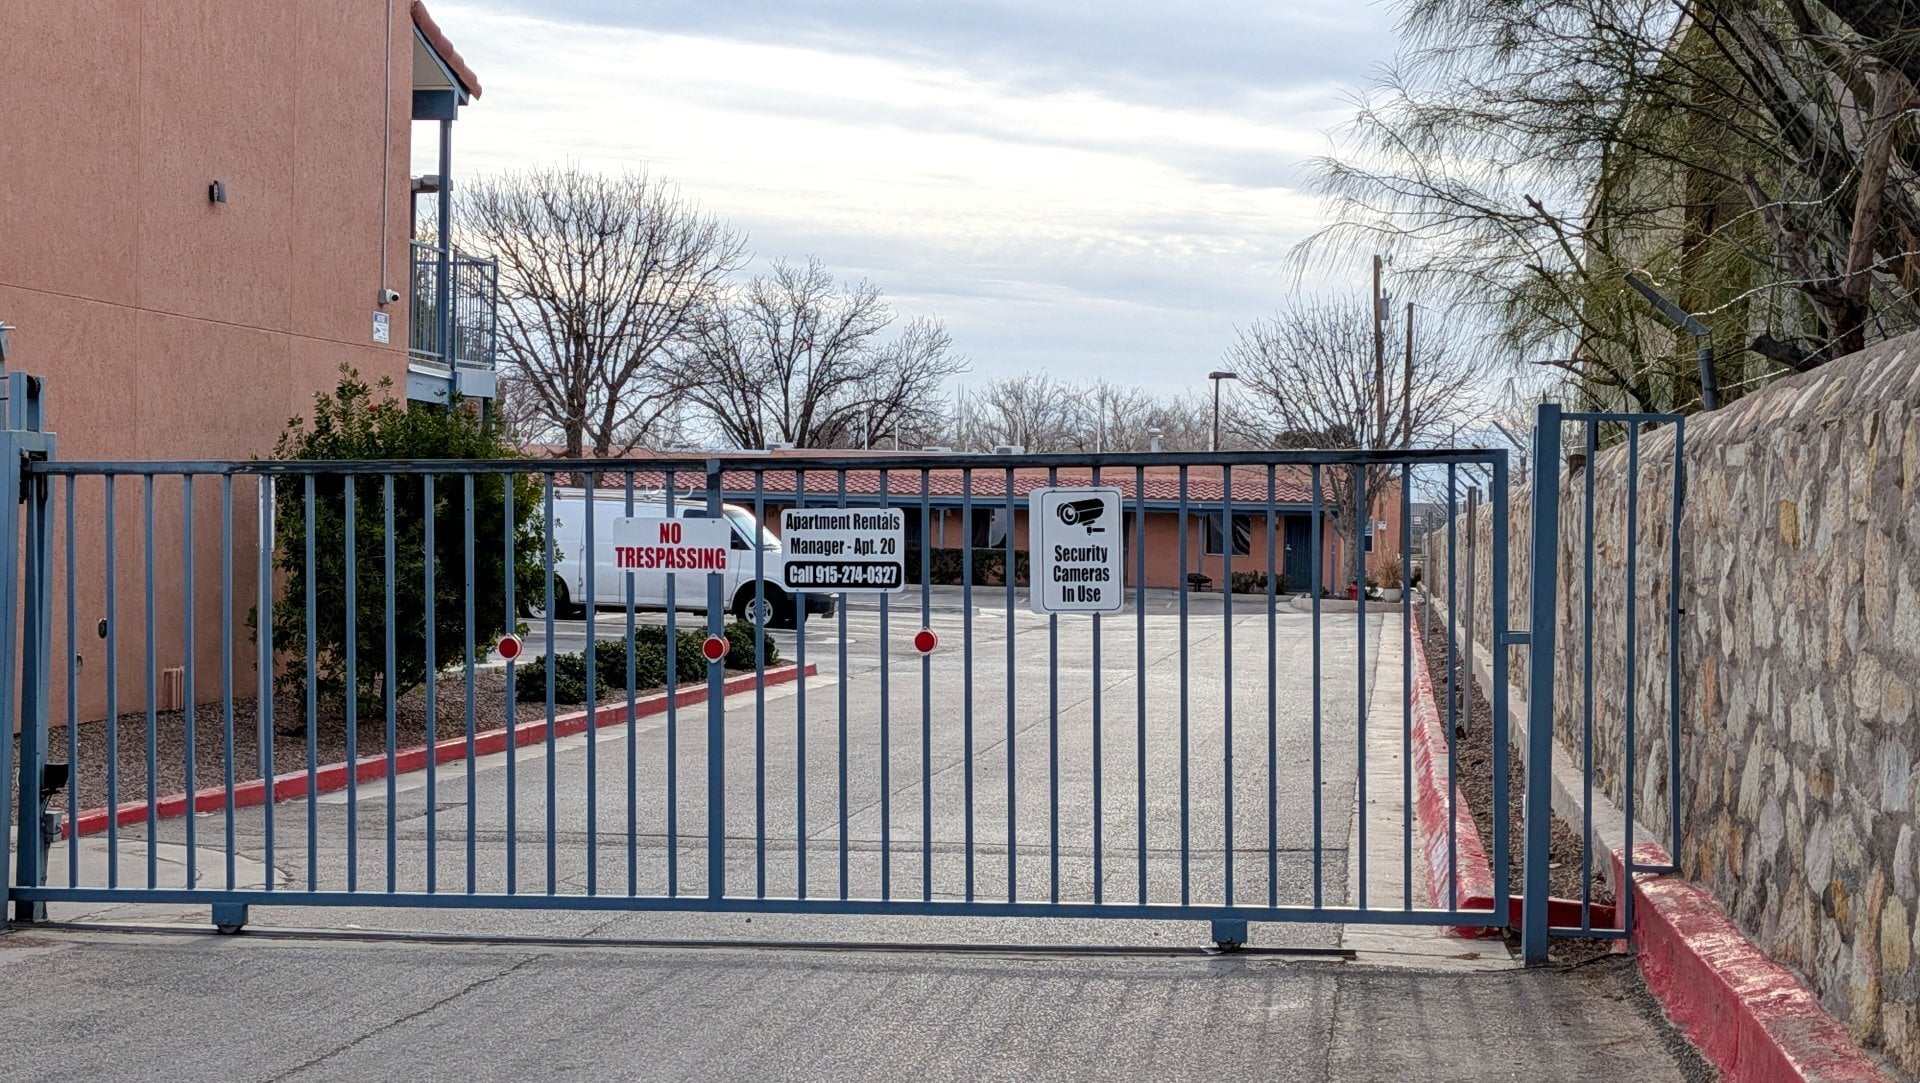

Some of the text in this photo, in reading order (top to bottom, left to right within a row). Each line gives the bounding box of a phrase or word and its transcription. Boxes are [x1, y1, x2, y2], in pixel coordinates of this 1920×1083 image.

[785, 513, 900, 531] Apartment Rentals
[659, 522, 682, 544] NO
[790, 537, 845, 556] Manager
[853, 537, 878, 556] Apt.
[879, 537, 896, 555] 20
[1054, 544, 1108, 563] Security
[615, 547, 726, 569] TRESPASSING
[789, 565, 898, 584] Call 915-274-0327
[1053, 565, 1110, 582] Cameras
[1062, 585, 1101, 602] In Use
